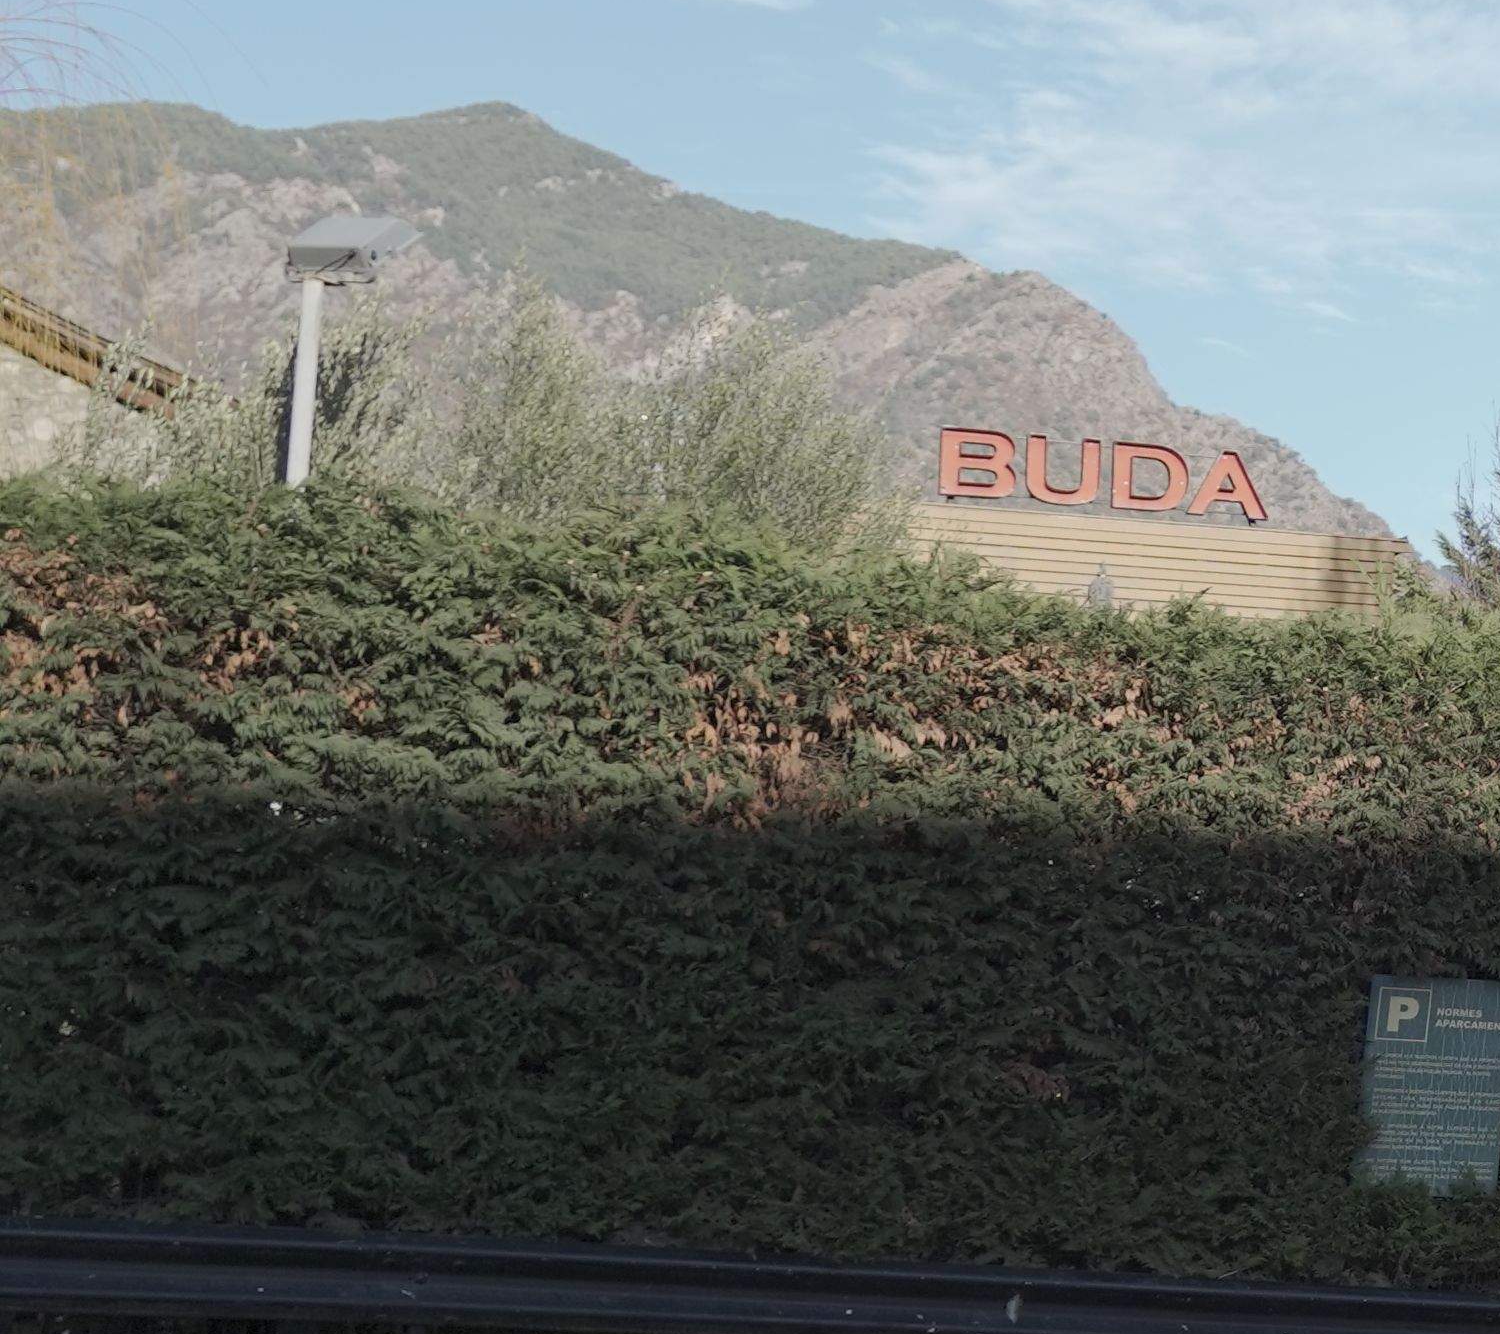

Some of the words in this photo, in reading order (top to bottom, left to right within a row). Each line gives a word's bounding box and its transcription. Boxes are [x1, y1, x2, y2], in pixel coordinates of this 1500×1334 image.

[938, 426, 1269, 521] BUDA
[1386, 995, 1419, 1033] P
[1436, 1007, 1483, 1018] NORMES
